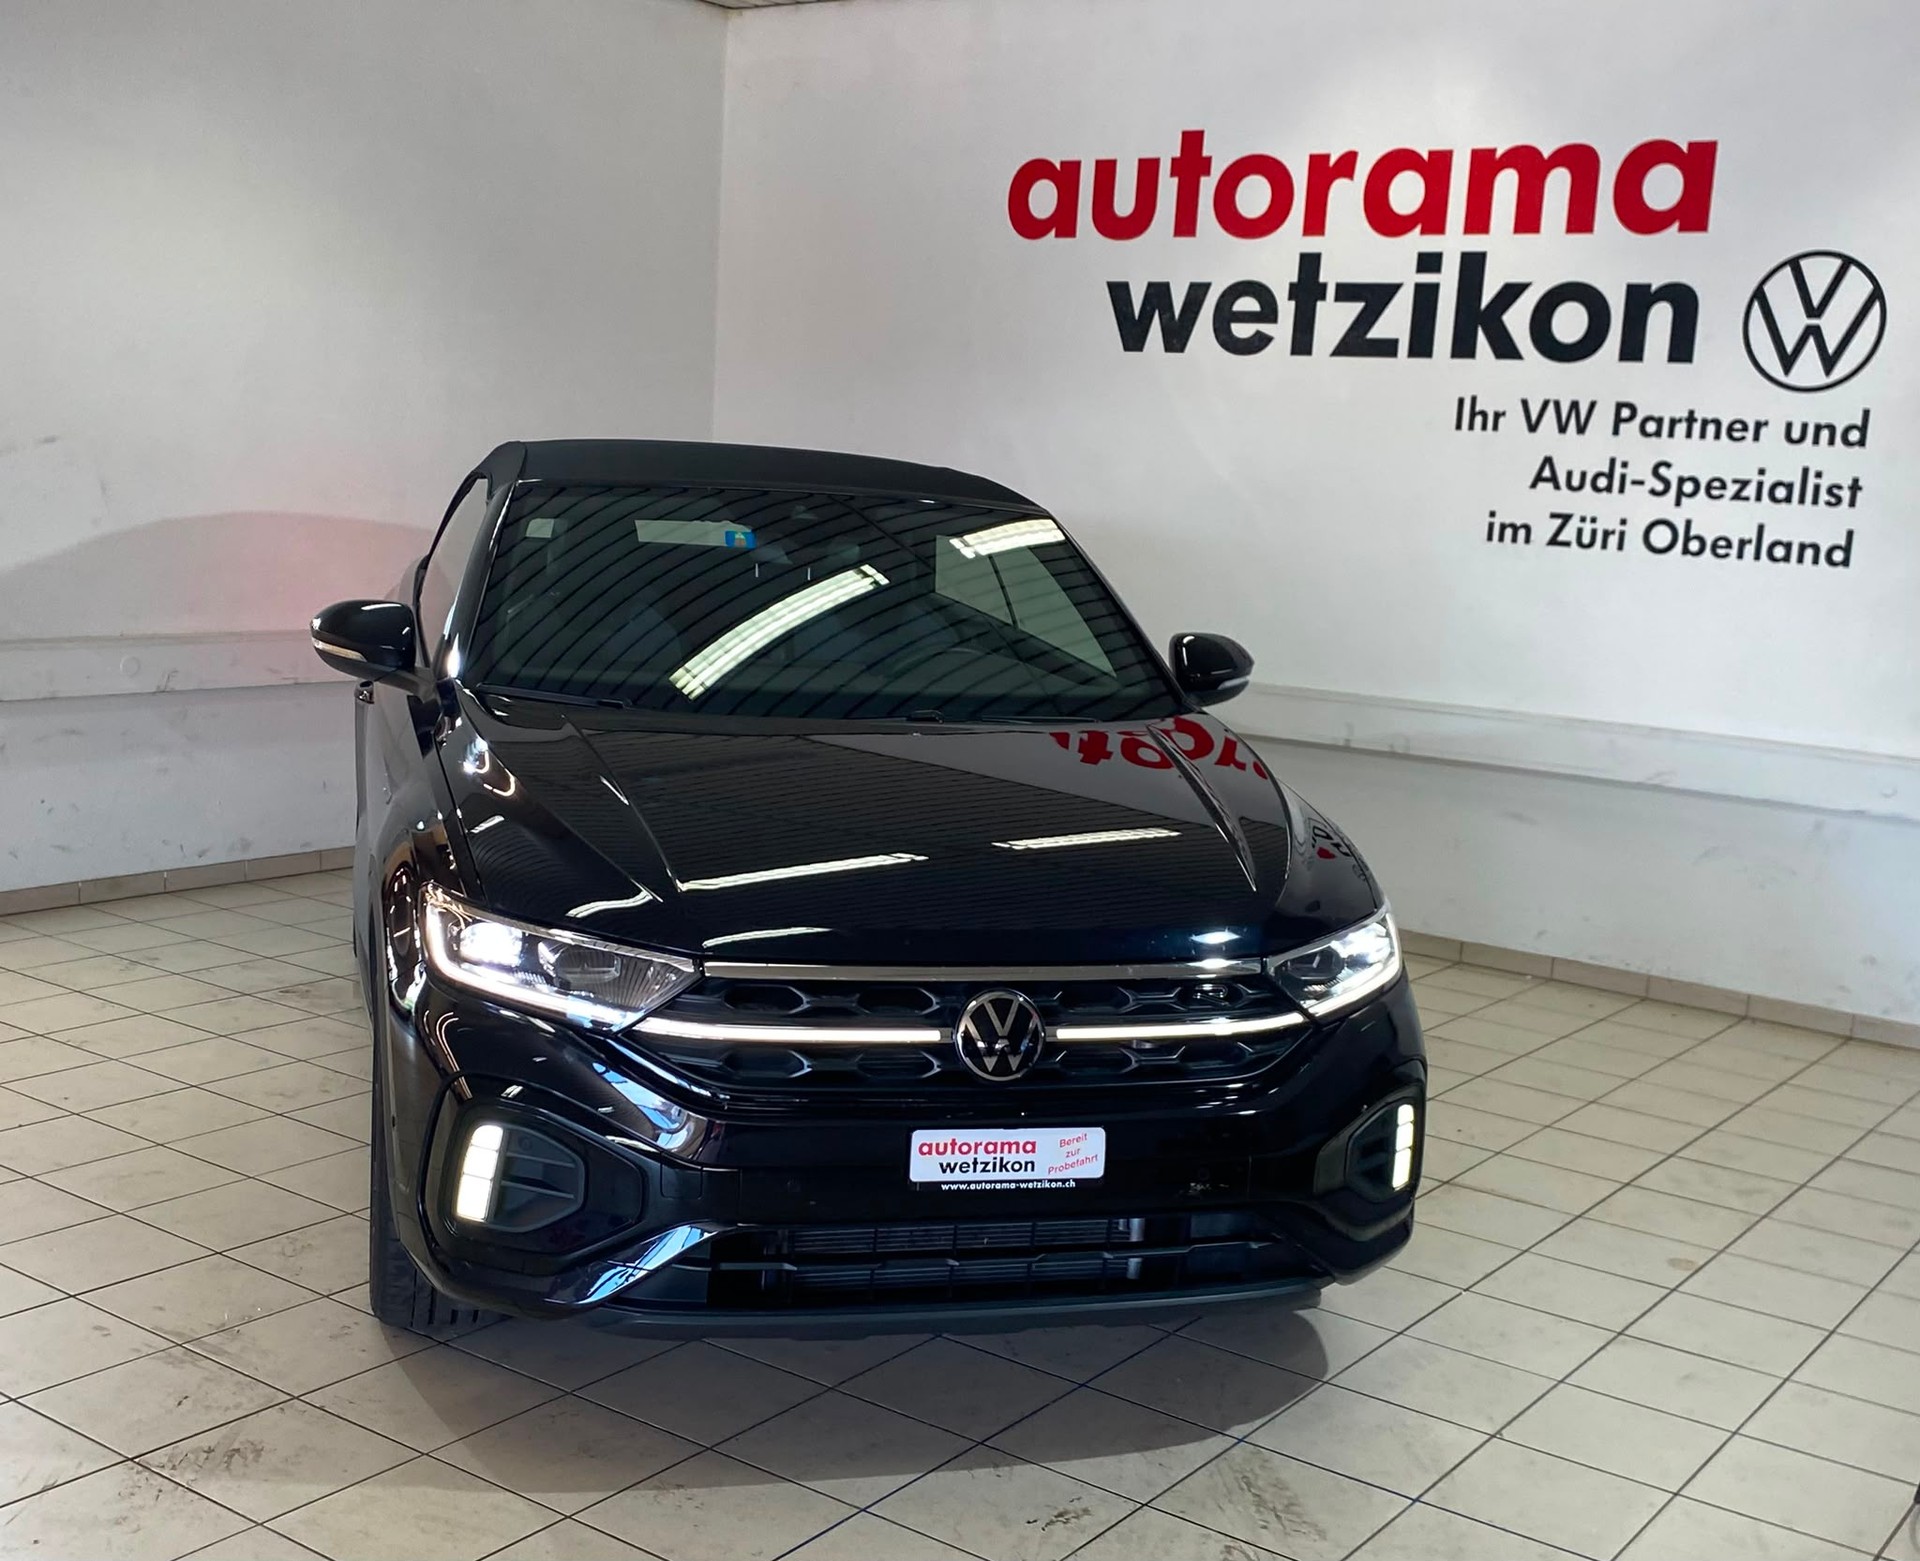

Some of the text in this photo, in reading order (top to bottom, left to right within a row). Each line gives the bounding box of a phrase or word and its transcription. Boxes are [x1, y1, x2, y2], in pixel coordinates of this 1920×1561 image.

[1007, 129, 1718, 241] autorama
[1106, 251, 1699, 364] wetzikon
[1455, 395, 1871, 448] Ihr VW Partner und
[1529, 456, 1863, 509] Audi-Spezialist
[1486, 510, 1854, 568] im Züri Oberland
[918, 1138, 1037, 1156] autorama
[1060, 1133, 1087, 1147] Bereit
[1066, 1147, 1080, 1157] zur
[939, 1156, 1036, 1174] wetzikon
[1048, 1154, 1098, 1174] Probefahrt
[941, 1180, 1075, 1190] www.autorama-wetzikon.ch
